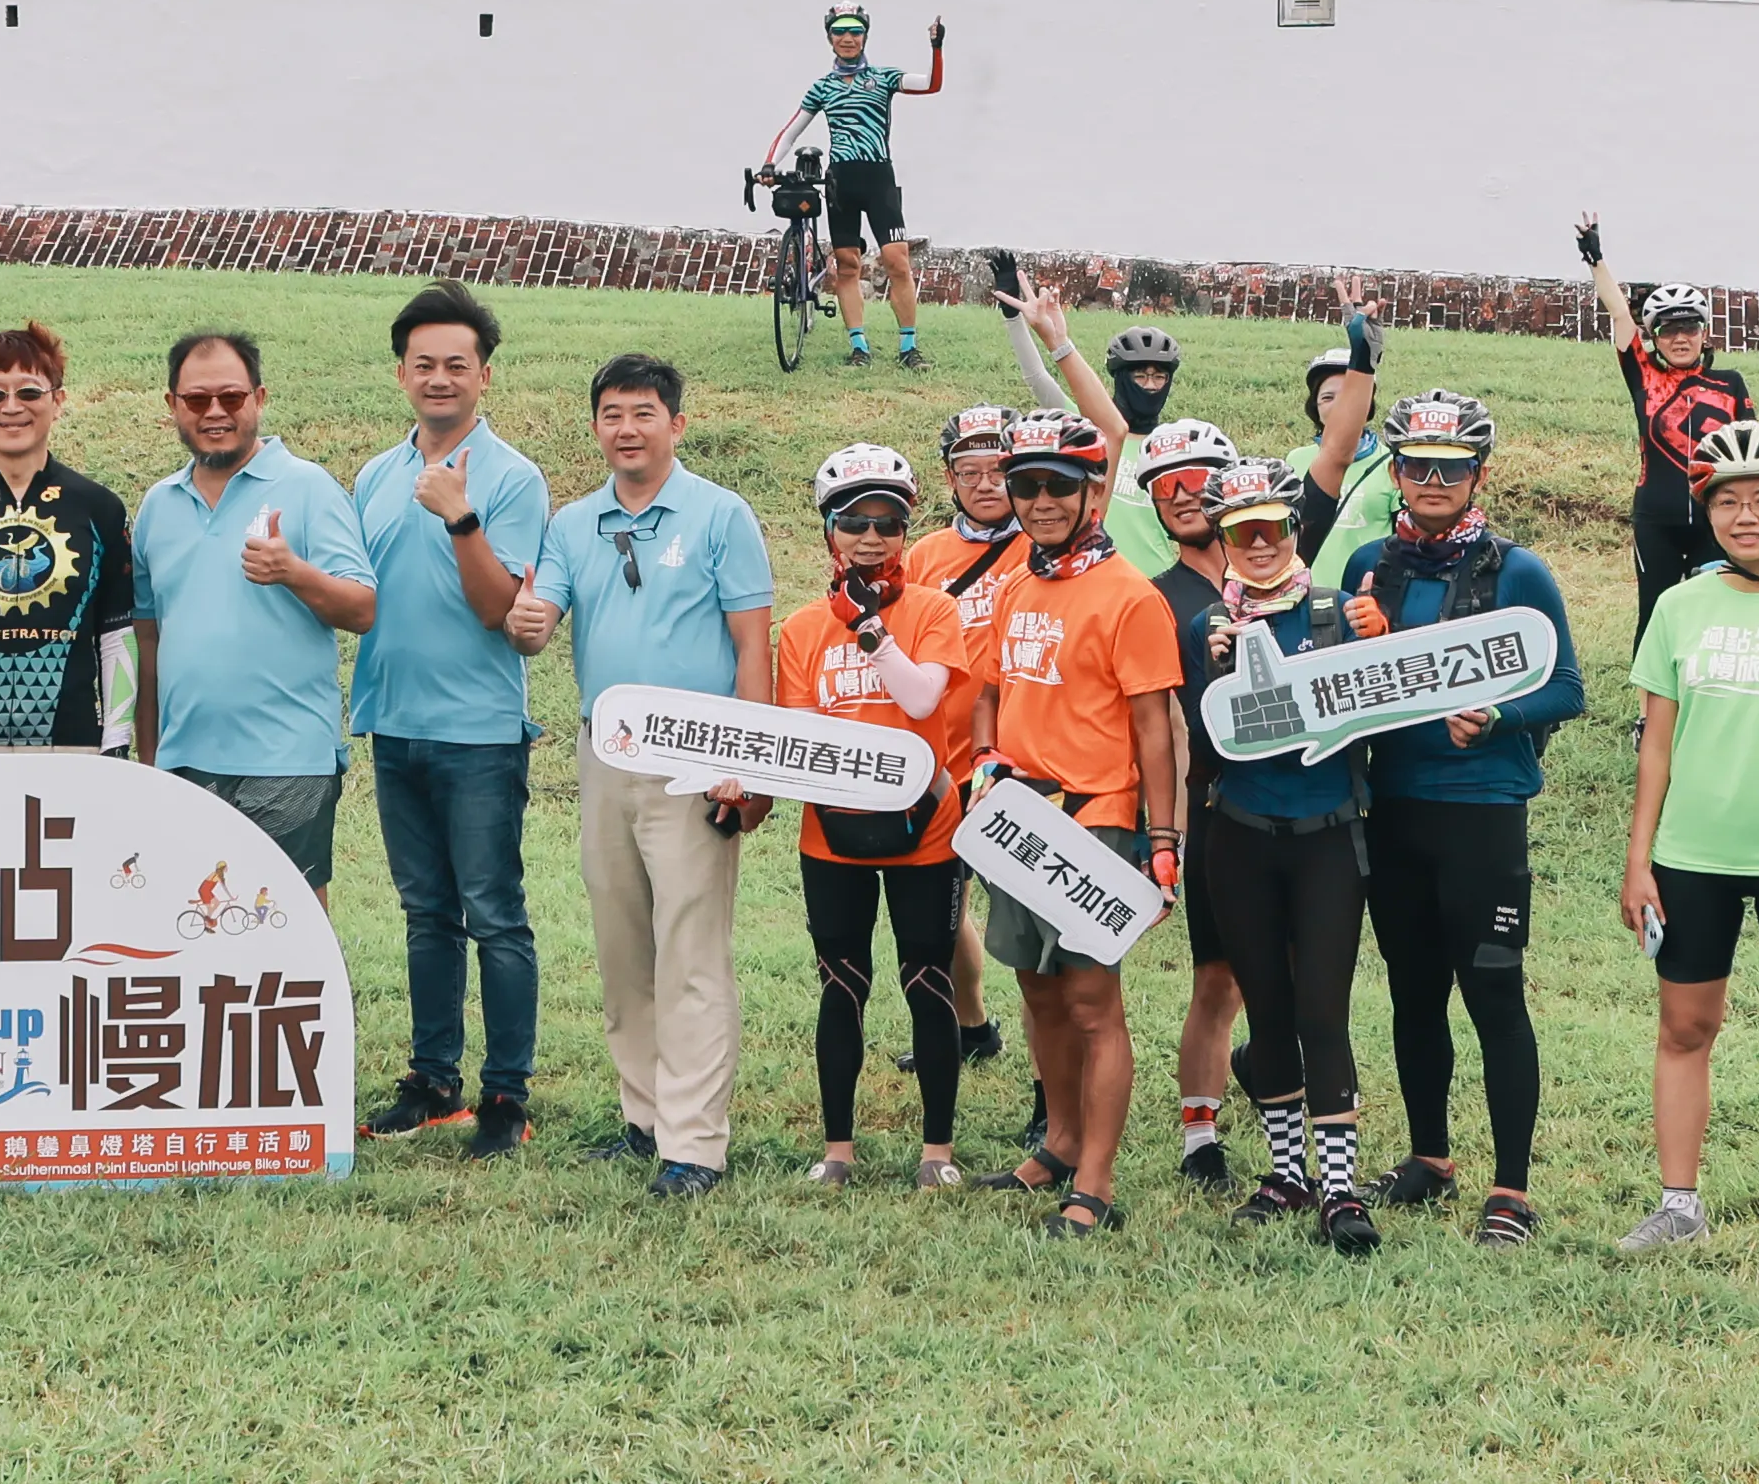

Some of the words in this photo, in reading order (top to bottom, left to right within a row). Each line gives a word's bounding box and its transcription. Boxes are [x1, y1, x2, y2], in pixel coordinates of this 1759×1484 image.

[1419, 410, 1449, 424] 100
[1021, 427, 1051, 440] 217
[1154, 434, 1182, 449] 102
[1230, 474, 1260, 487] 101
[41, 628, 77, 641] TECH
[1309, 631, 1530, 718] 鵝鑾鼻公園
[641, 713, 907, 787] 悠遊探索恆春半島
[980, 809, 1138, 937] 加量不加價
[58, 971, 326, 1112] 慢旅
[95, 1161, 126, 1174] Point
[182, 1158, 251, 1175] Lighthouse
[255, 1157, 281, 1170] Bike
[284, 1157, 311, 1169] Tour
